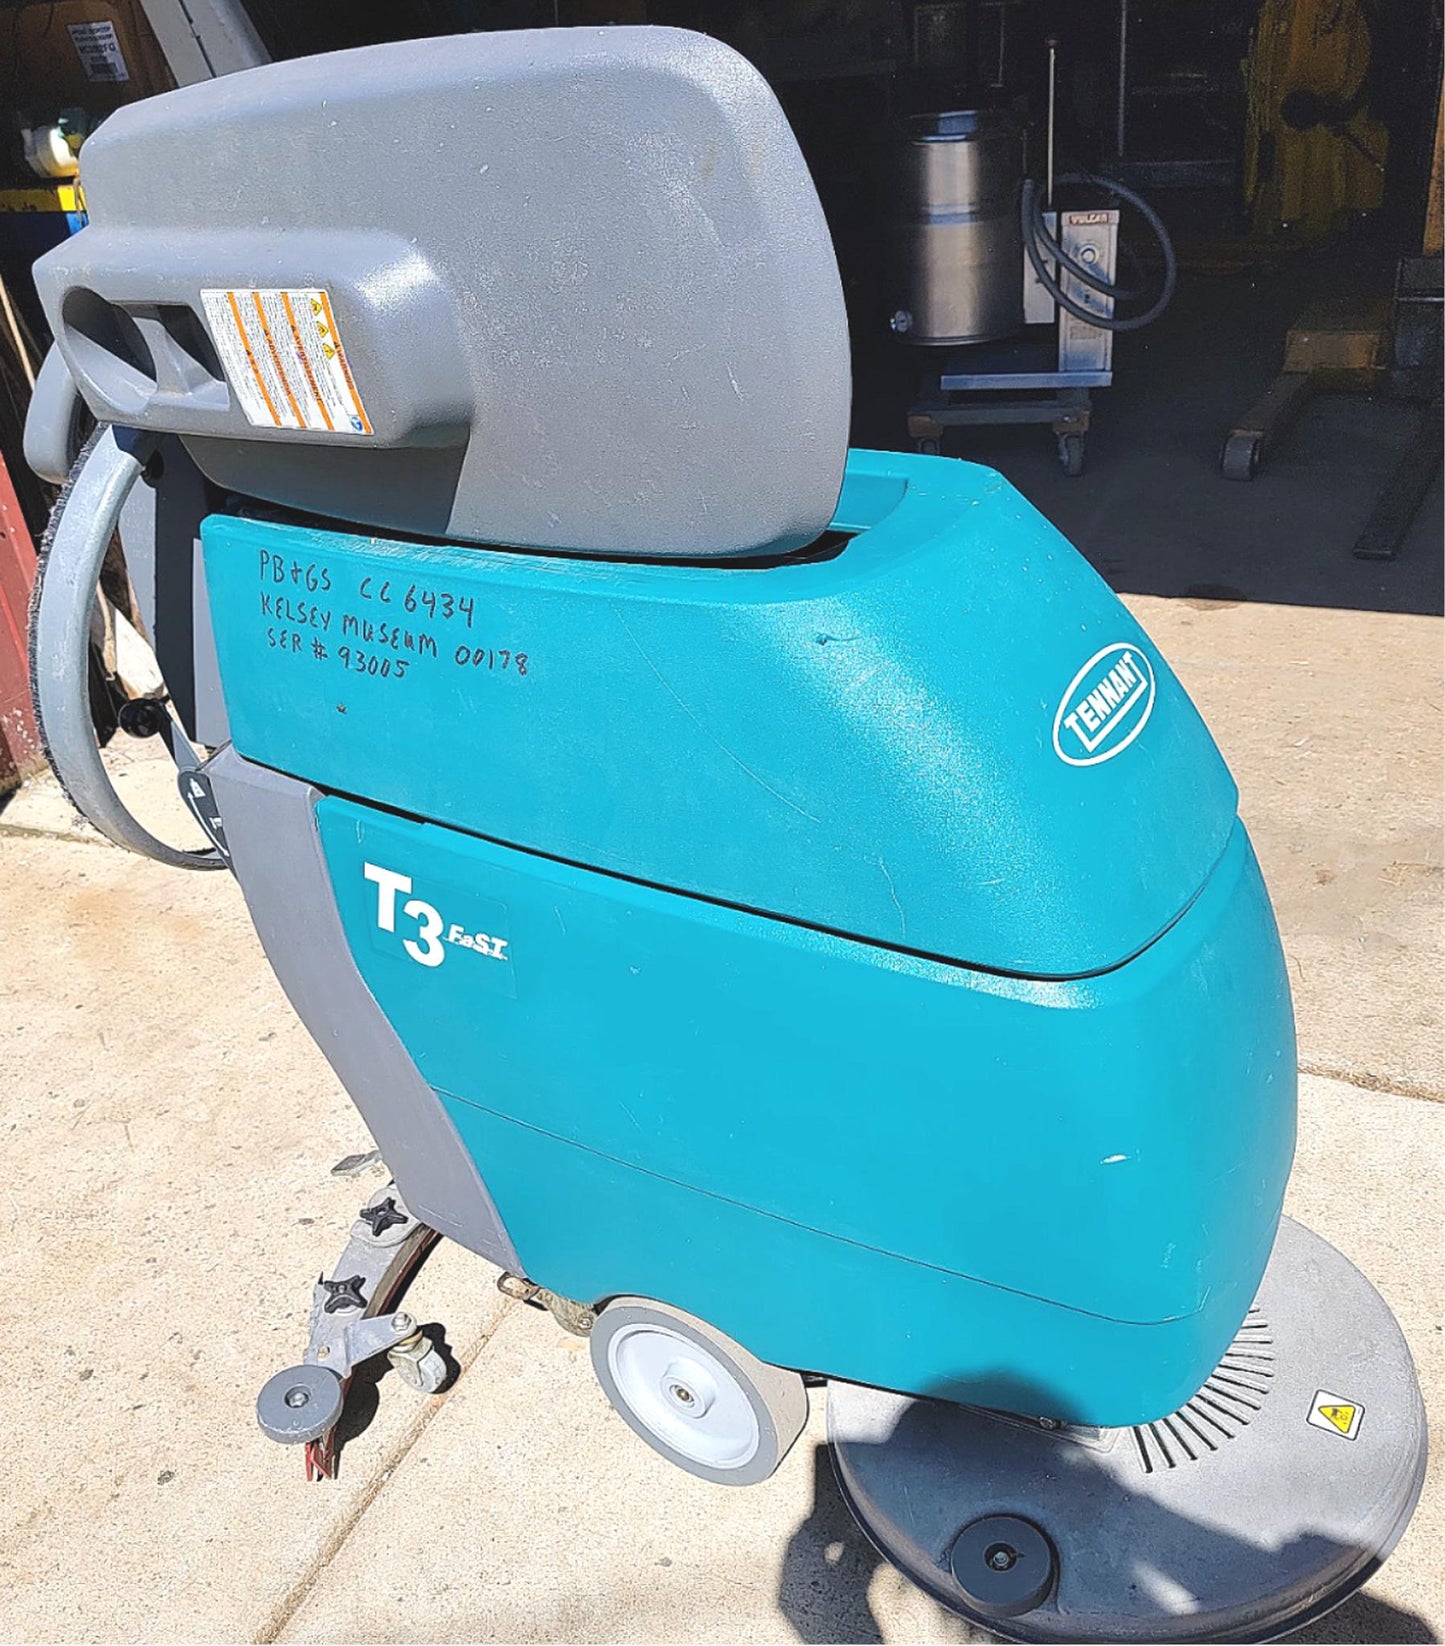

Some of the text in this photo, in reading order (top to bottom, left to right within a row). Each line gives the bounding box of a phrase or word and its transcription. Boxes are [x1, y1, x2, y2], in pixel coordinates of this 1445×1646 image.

[260, 592, 529, 676] KELSEY MUSEUM 00178
[403, 584, 475, 628] 6434
[266, 627, 410, 678] SER # 93005
[1063, 651, 1149, 753] TENNANT
[363, 861, 446, 968] T3
